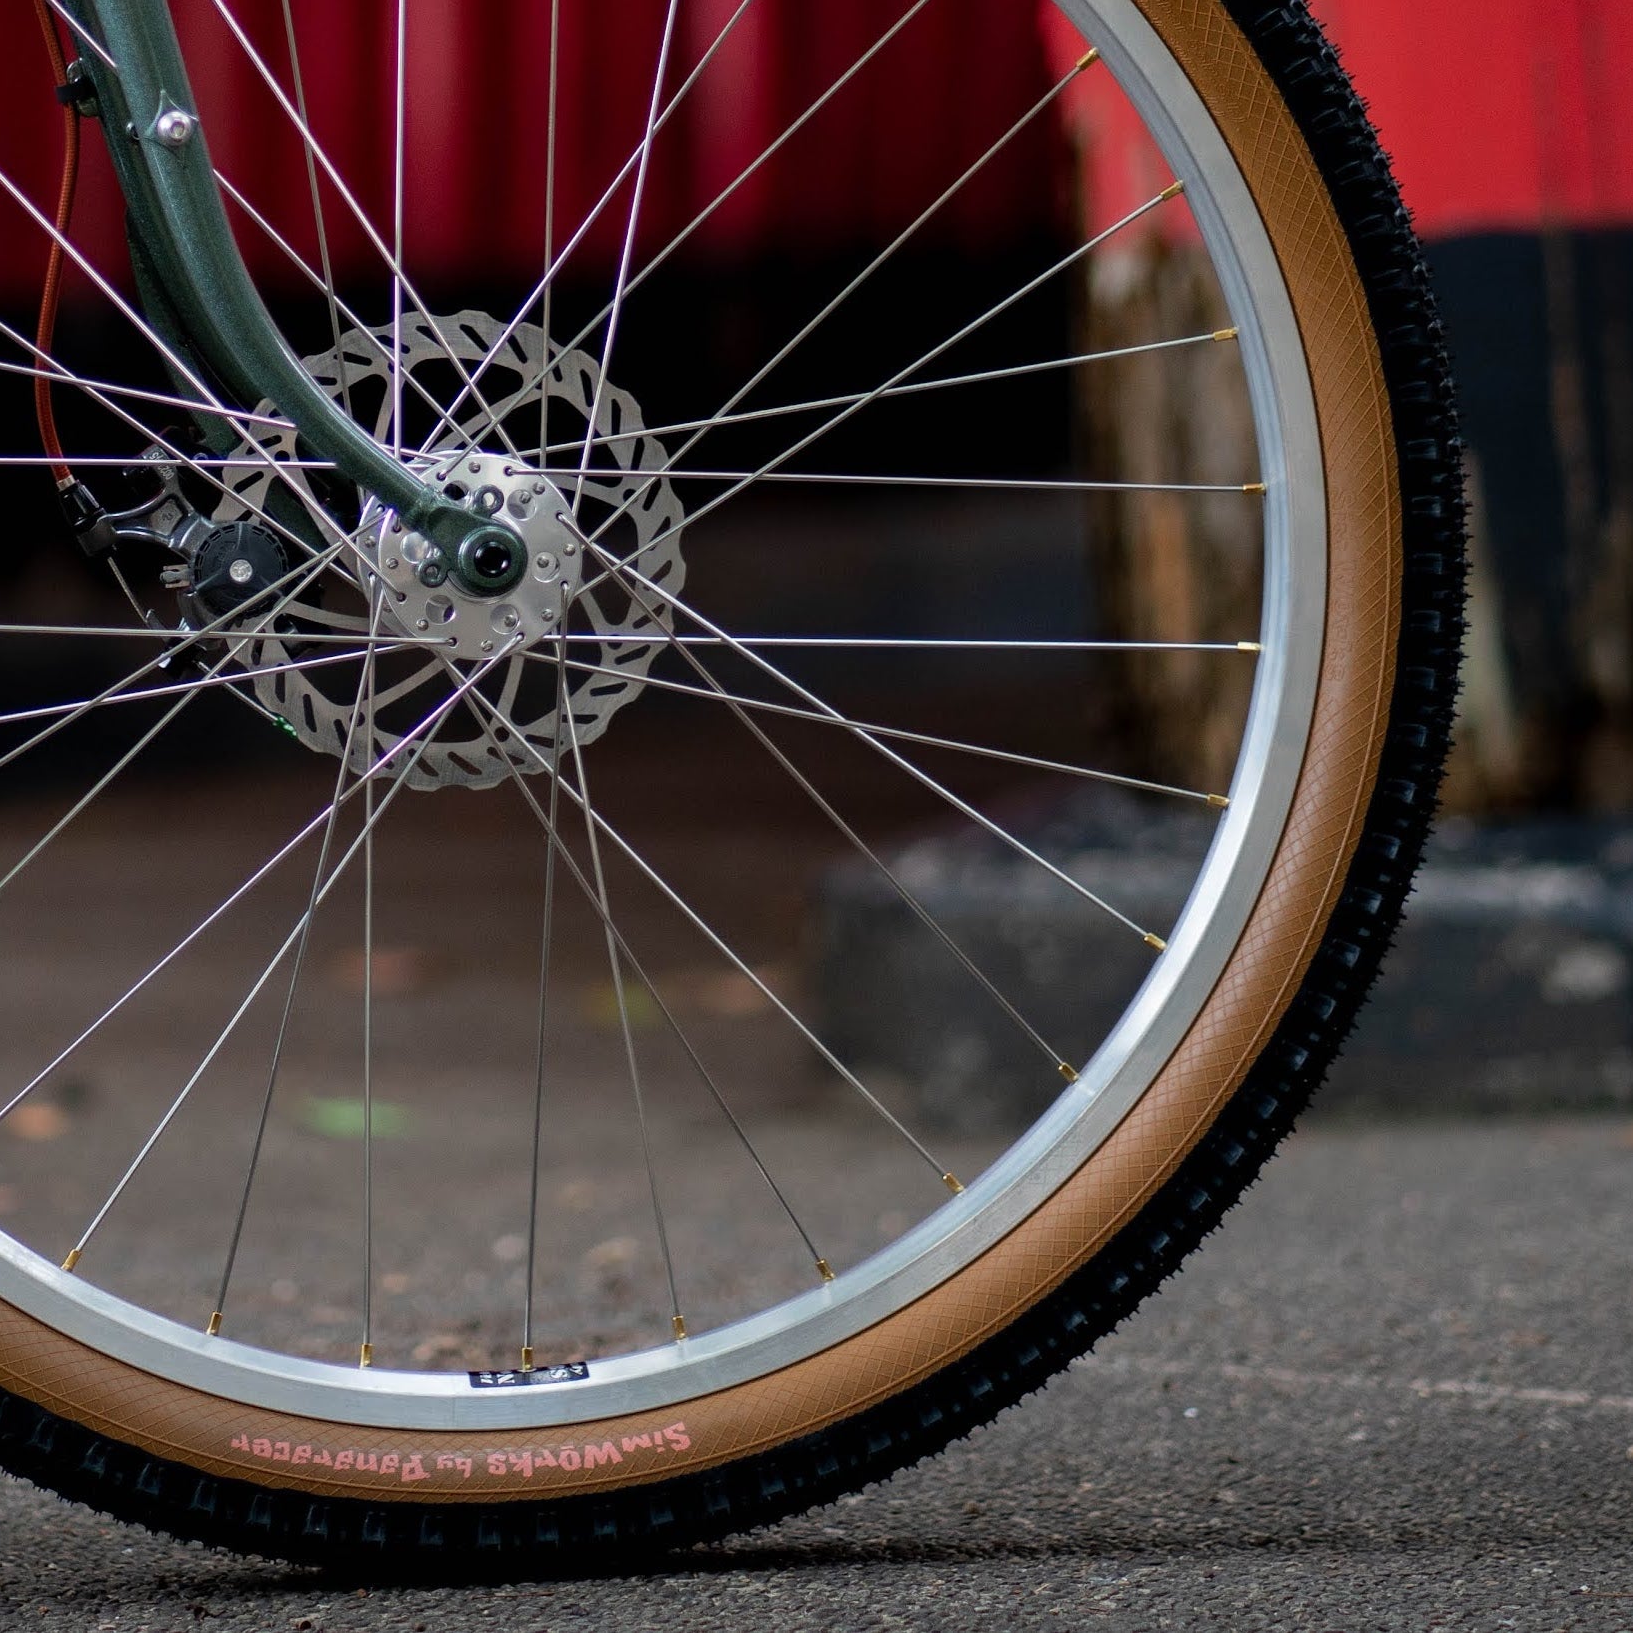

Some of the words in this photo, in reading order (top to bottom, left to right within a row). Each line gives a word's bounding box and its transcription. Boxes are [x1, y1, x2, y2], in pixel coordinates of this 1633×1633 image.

[230, 1432, 432, 1482] Panaracer
[436, 1453, 473, 1479] by
[486, 1421, 692, 1478] SimWorks
